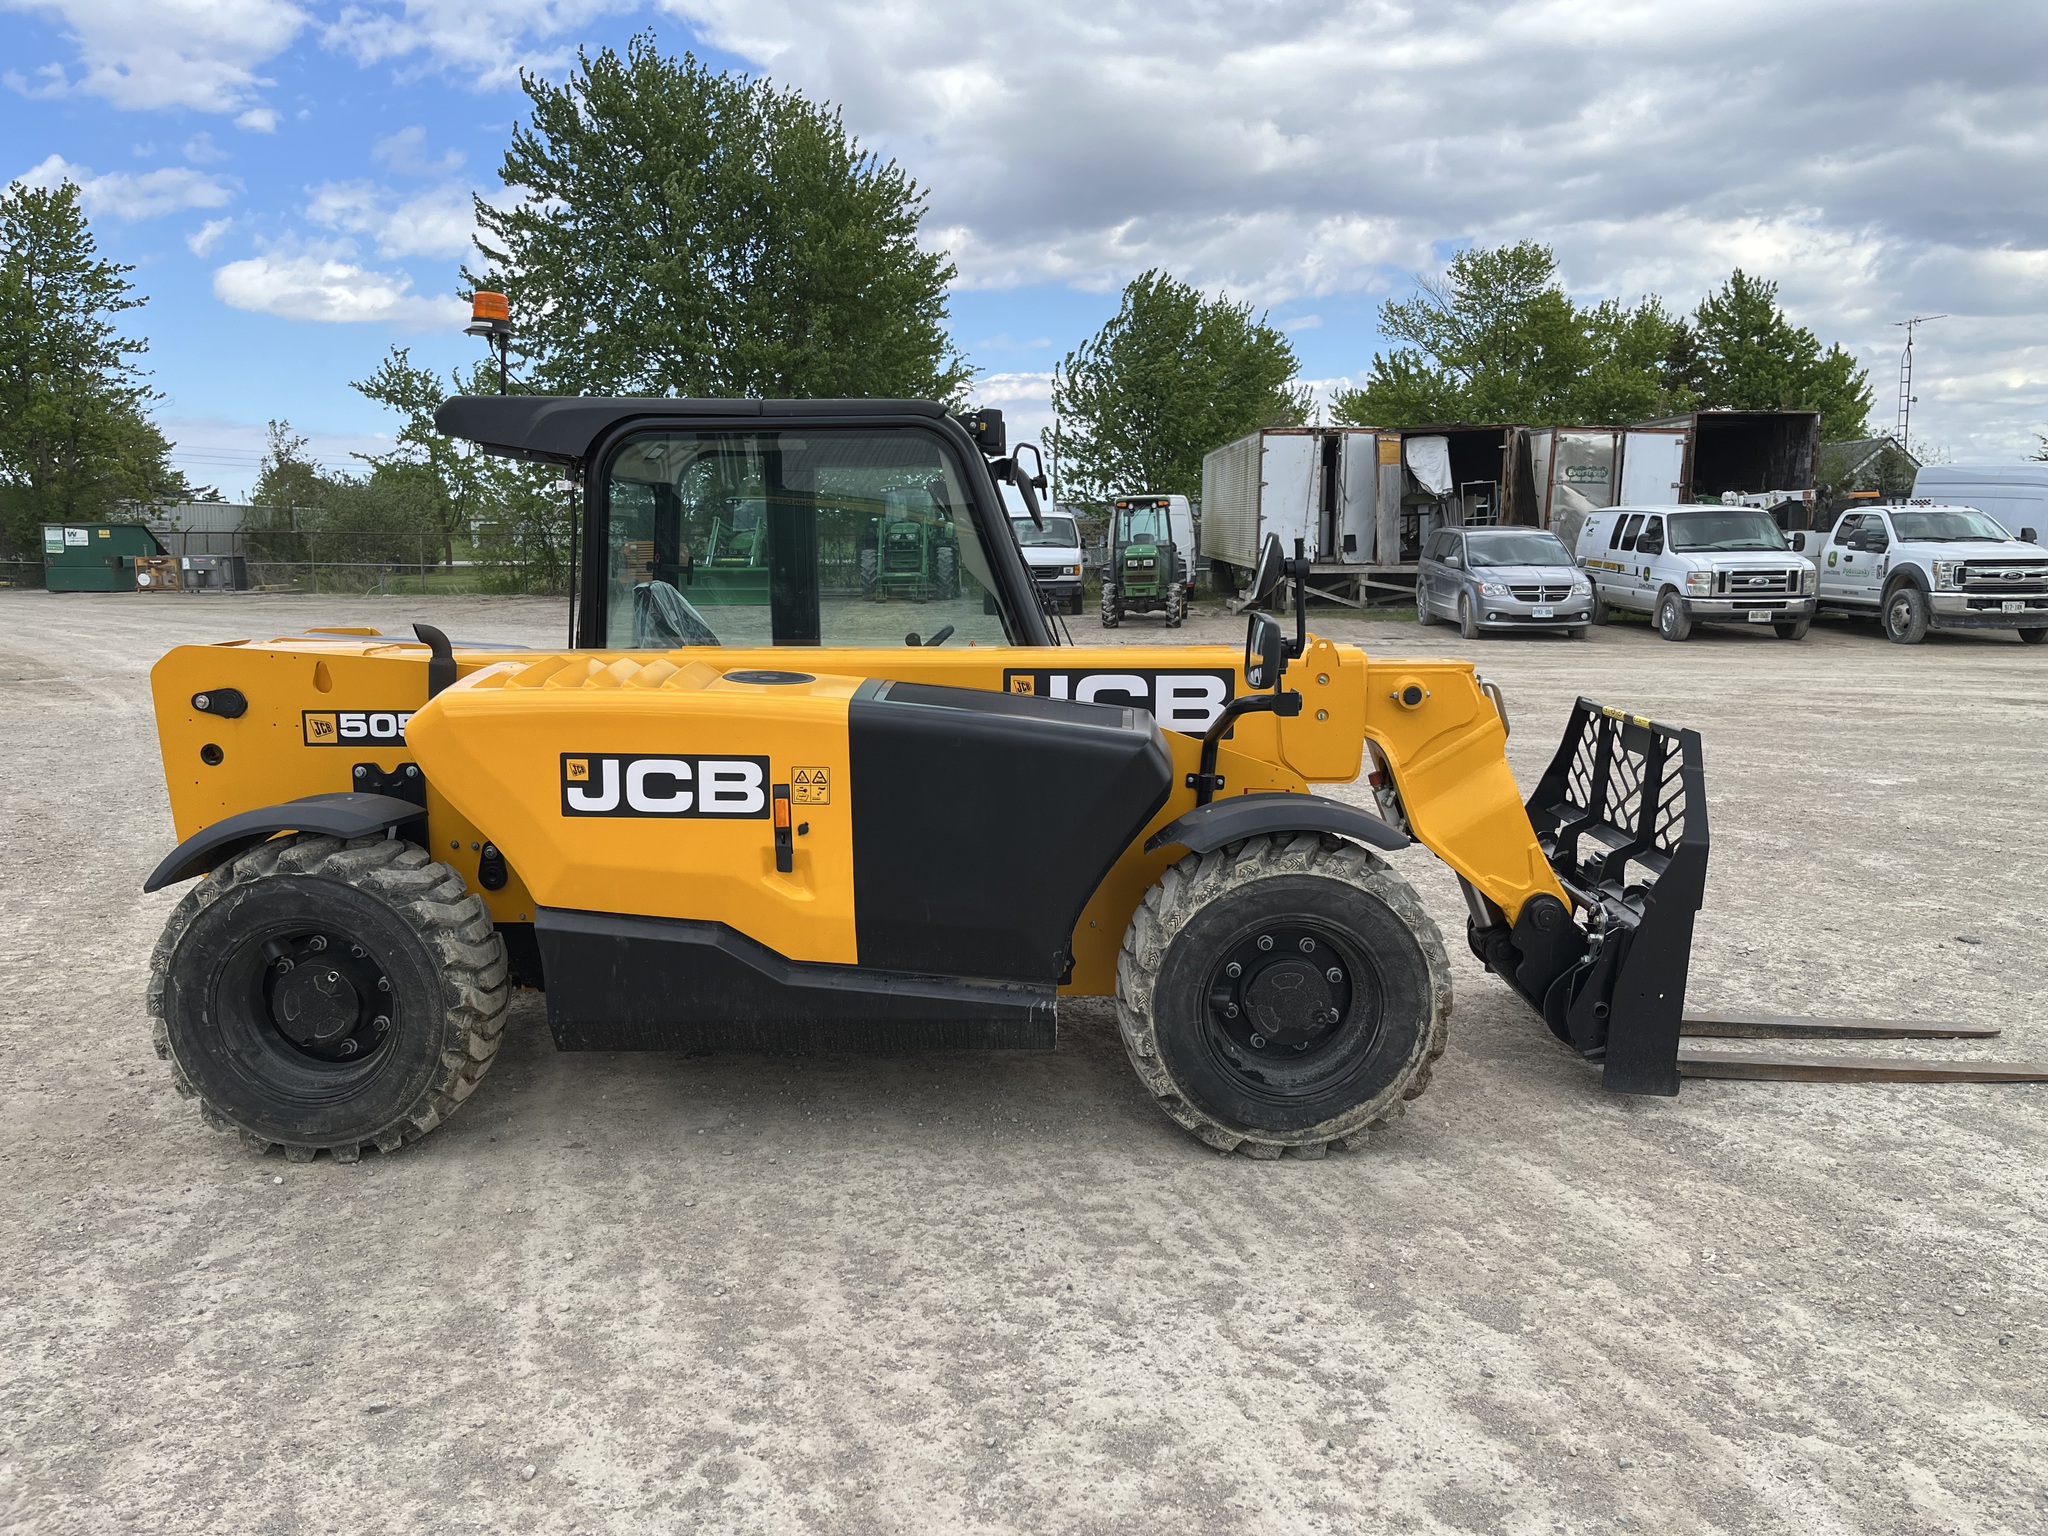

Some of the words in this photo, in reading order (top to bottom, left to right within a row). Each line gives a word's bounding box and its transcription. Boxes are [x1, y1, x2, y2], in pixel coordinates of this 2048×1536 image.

[313, 721, 333, 736] JCB
[571, 764, 586, 775] JCB
[567, 759, 765, 813] JCB
